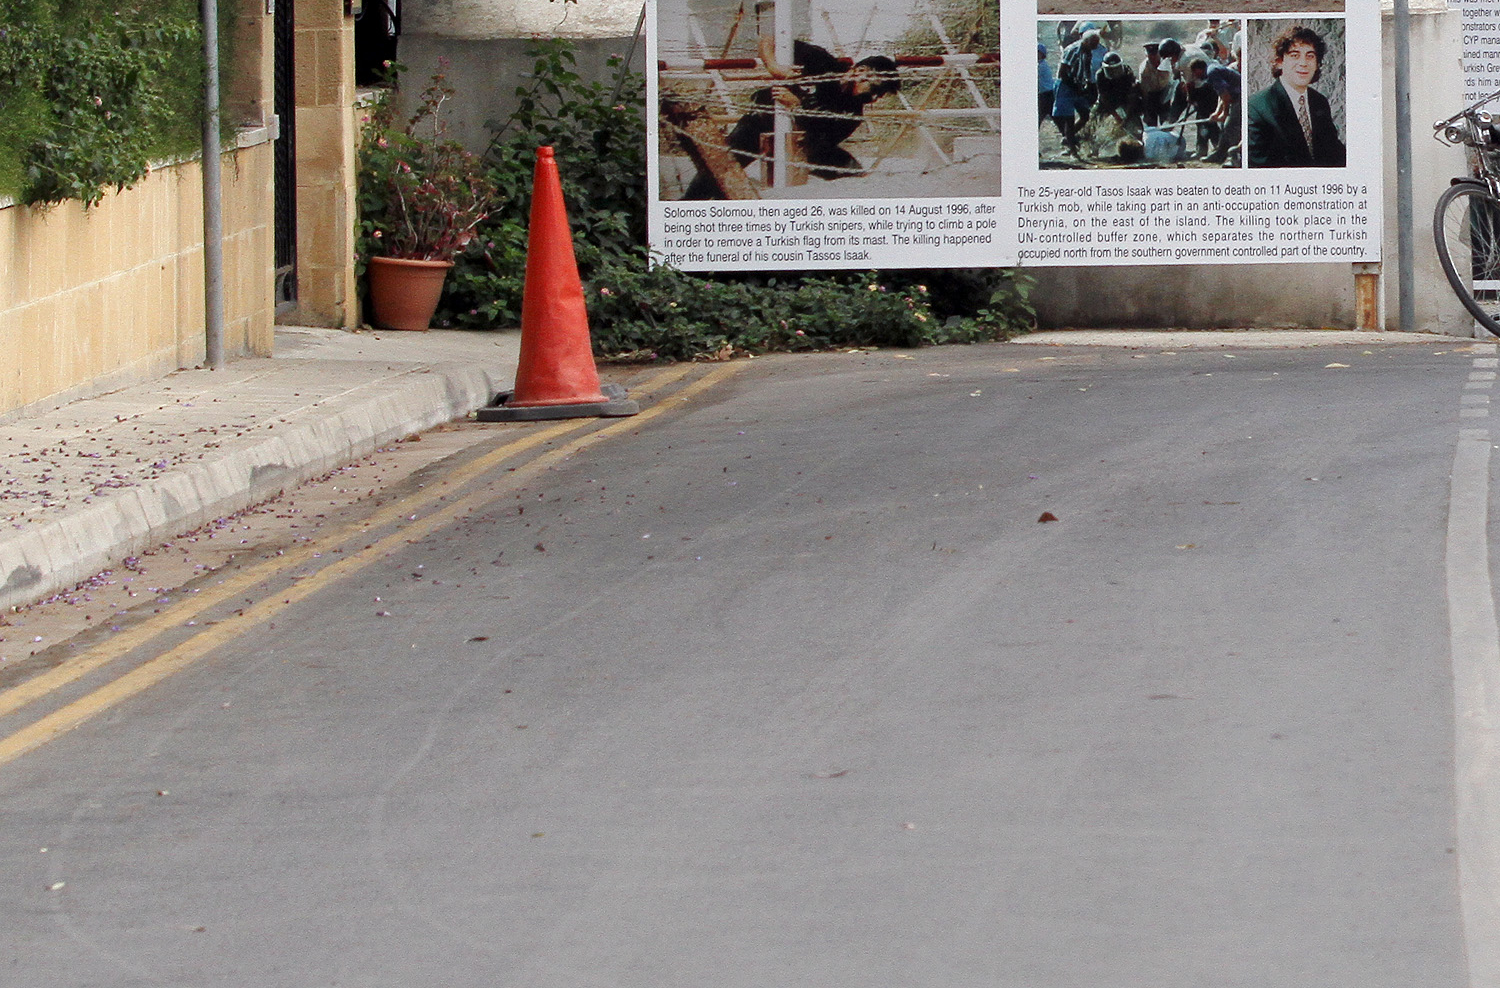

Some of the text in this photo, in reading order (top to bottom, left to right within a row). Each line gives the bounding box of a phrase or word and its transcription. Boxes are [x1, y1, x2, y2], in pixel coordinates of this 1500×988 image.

[1017, 183, 1367, 200] The 25-year-old Tasos Isaak was beaten to death on 11 August 1996 by a
[663, 202, 995, 219] Solomos Solomou, then aged 26, was killed on 14 August 1996, after
[1017, 198, 1367, 214] Turkish mob, while taking part in an anti-occupation demonstration at
[664, 217, 996, 235] being shot three times by Turkish snipers, while trying to climb a pole
[1018, 213, 1367, 230] Dherynia, on the east of the island. The killing took place in the
[664, 232, 991, 248] in order to remove a Turkish flag from its mast. The killing happened
[1017, 229, 1367, 244] UN-controlled buffer zone, which separates the northern Turkish
[664, 249, 871, 263] after the funeral of his cousin Tassos Isaak.
[1017, 244, 1367, 260] occupied north from the southern government controlled part of the country.
